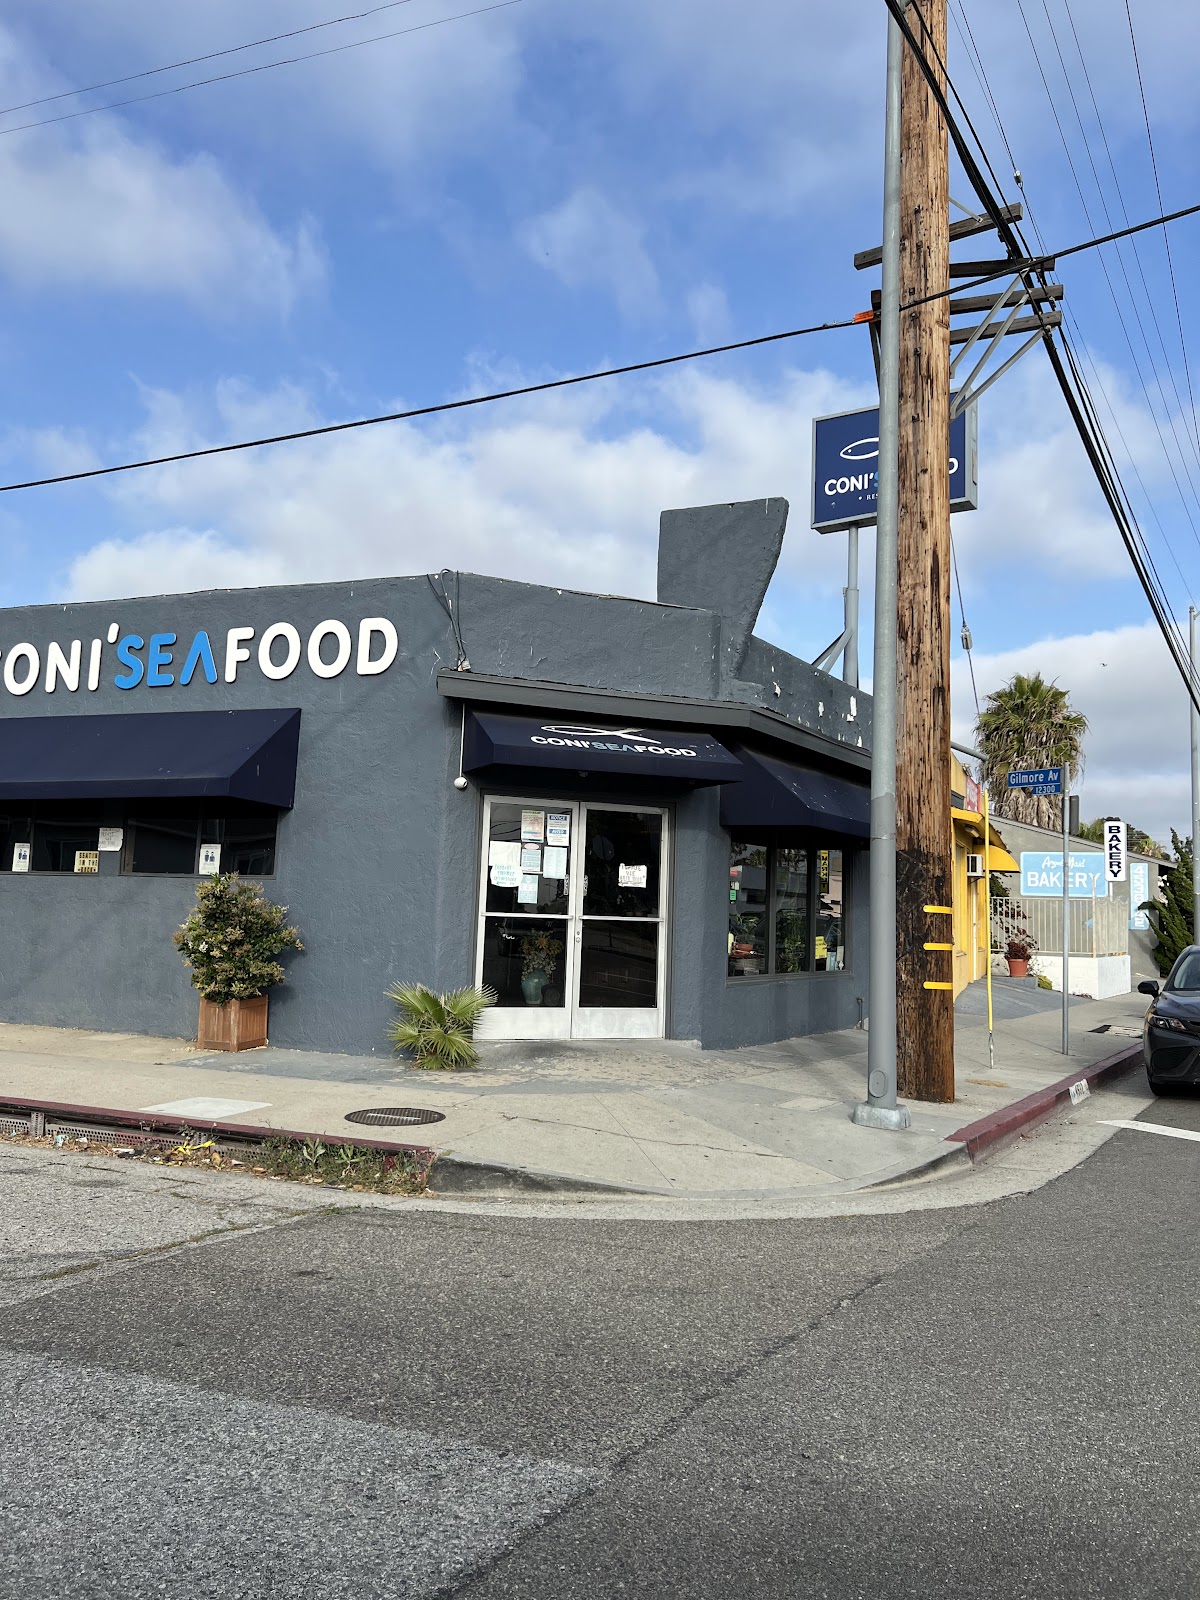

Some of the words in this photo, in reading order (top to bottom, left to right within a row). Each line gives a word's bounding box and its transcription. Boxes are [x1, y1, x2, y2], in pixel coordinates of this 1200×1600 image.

[0, 617, 399, 696] ONI'SEAFOOD
[1009, 773, 1045, 785] Gilmore
[1048, 770, 1059, 781] Av
[1035, 784, 1056, 794] 12300
[1108, 825, 1122, 878] BAKERY
[1027, 871, 1101, 888] BAKERY
